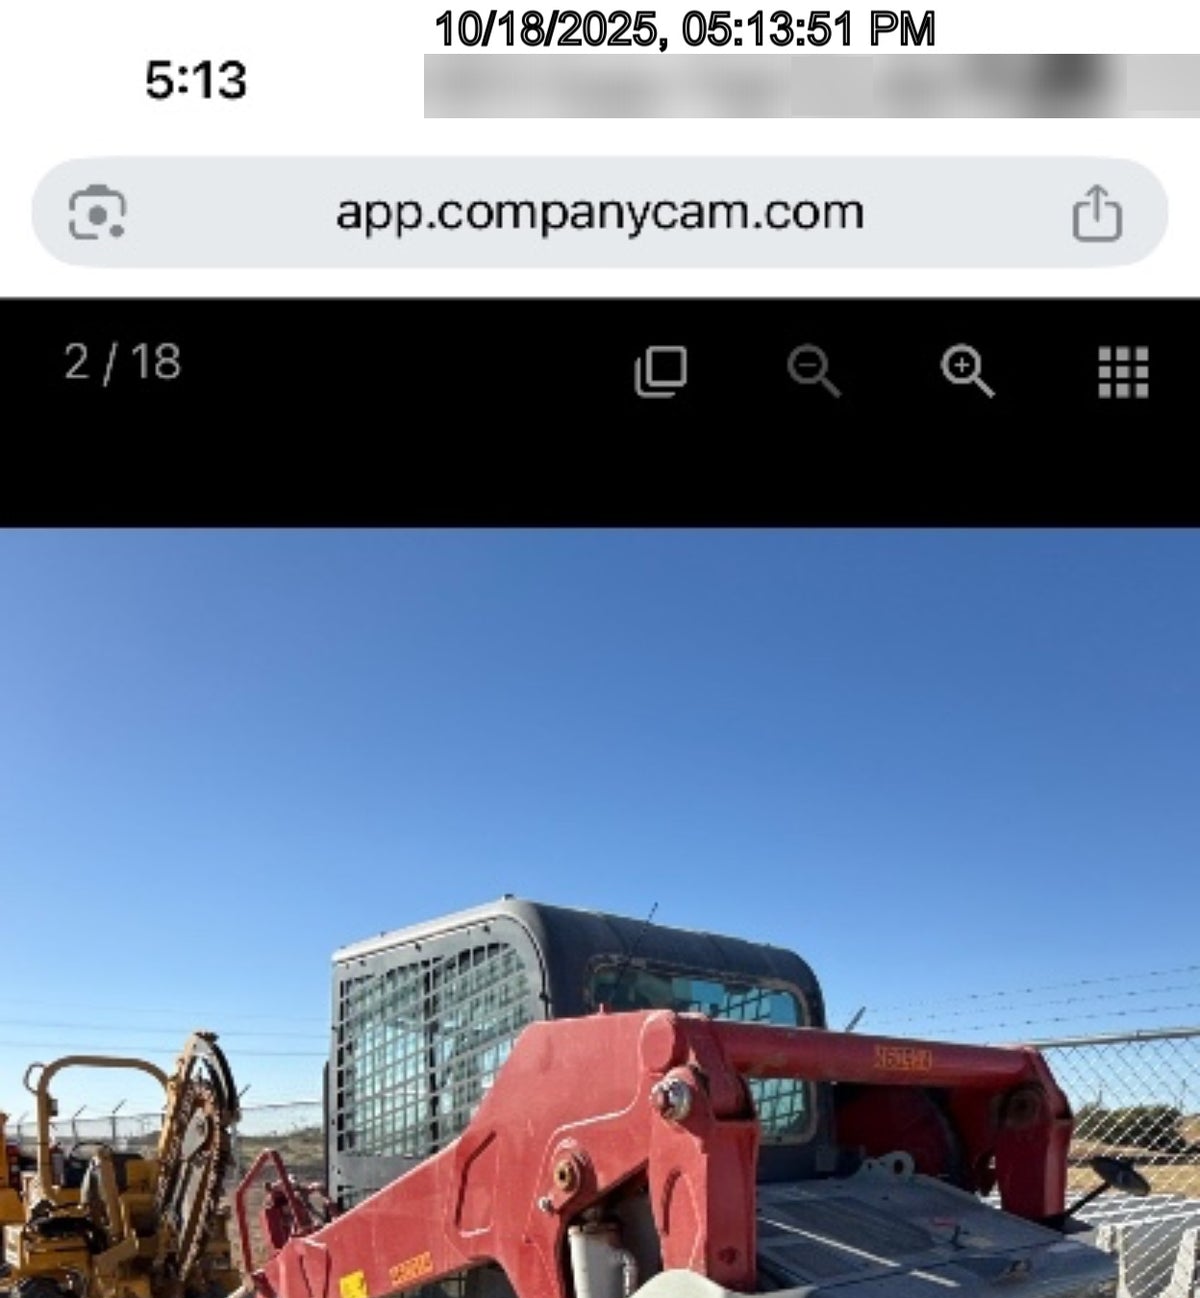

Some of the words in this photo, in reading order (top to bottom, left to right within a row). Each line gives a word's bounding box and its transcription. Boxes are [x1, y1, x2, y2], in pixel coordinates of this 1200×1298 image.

[146, 60, 247, 100] 5:13
[336, 199, 864, 240] app.companycam.com
[65, 342, 89, 379] 2
[132, 342, 181, 379] 18
